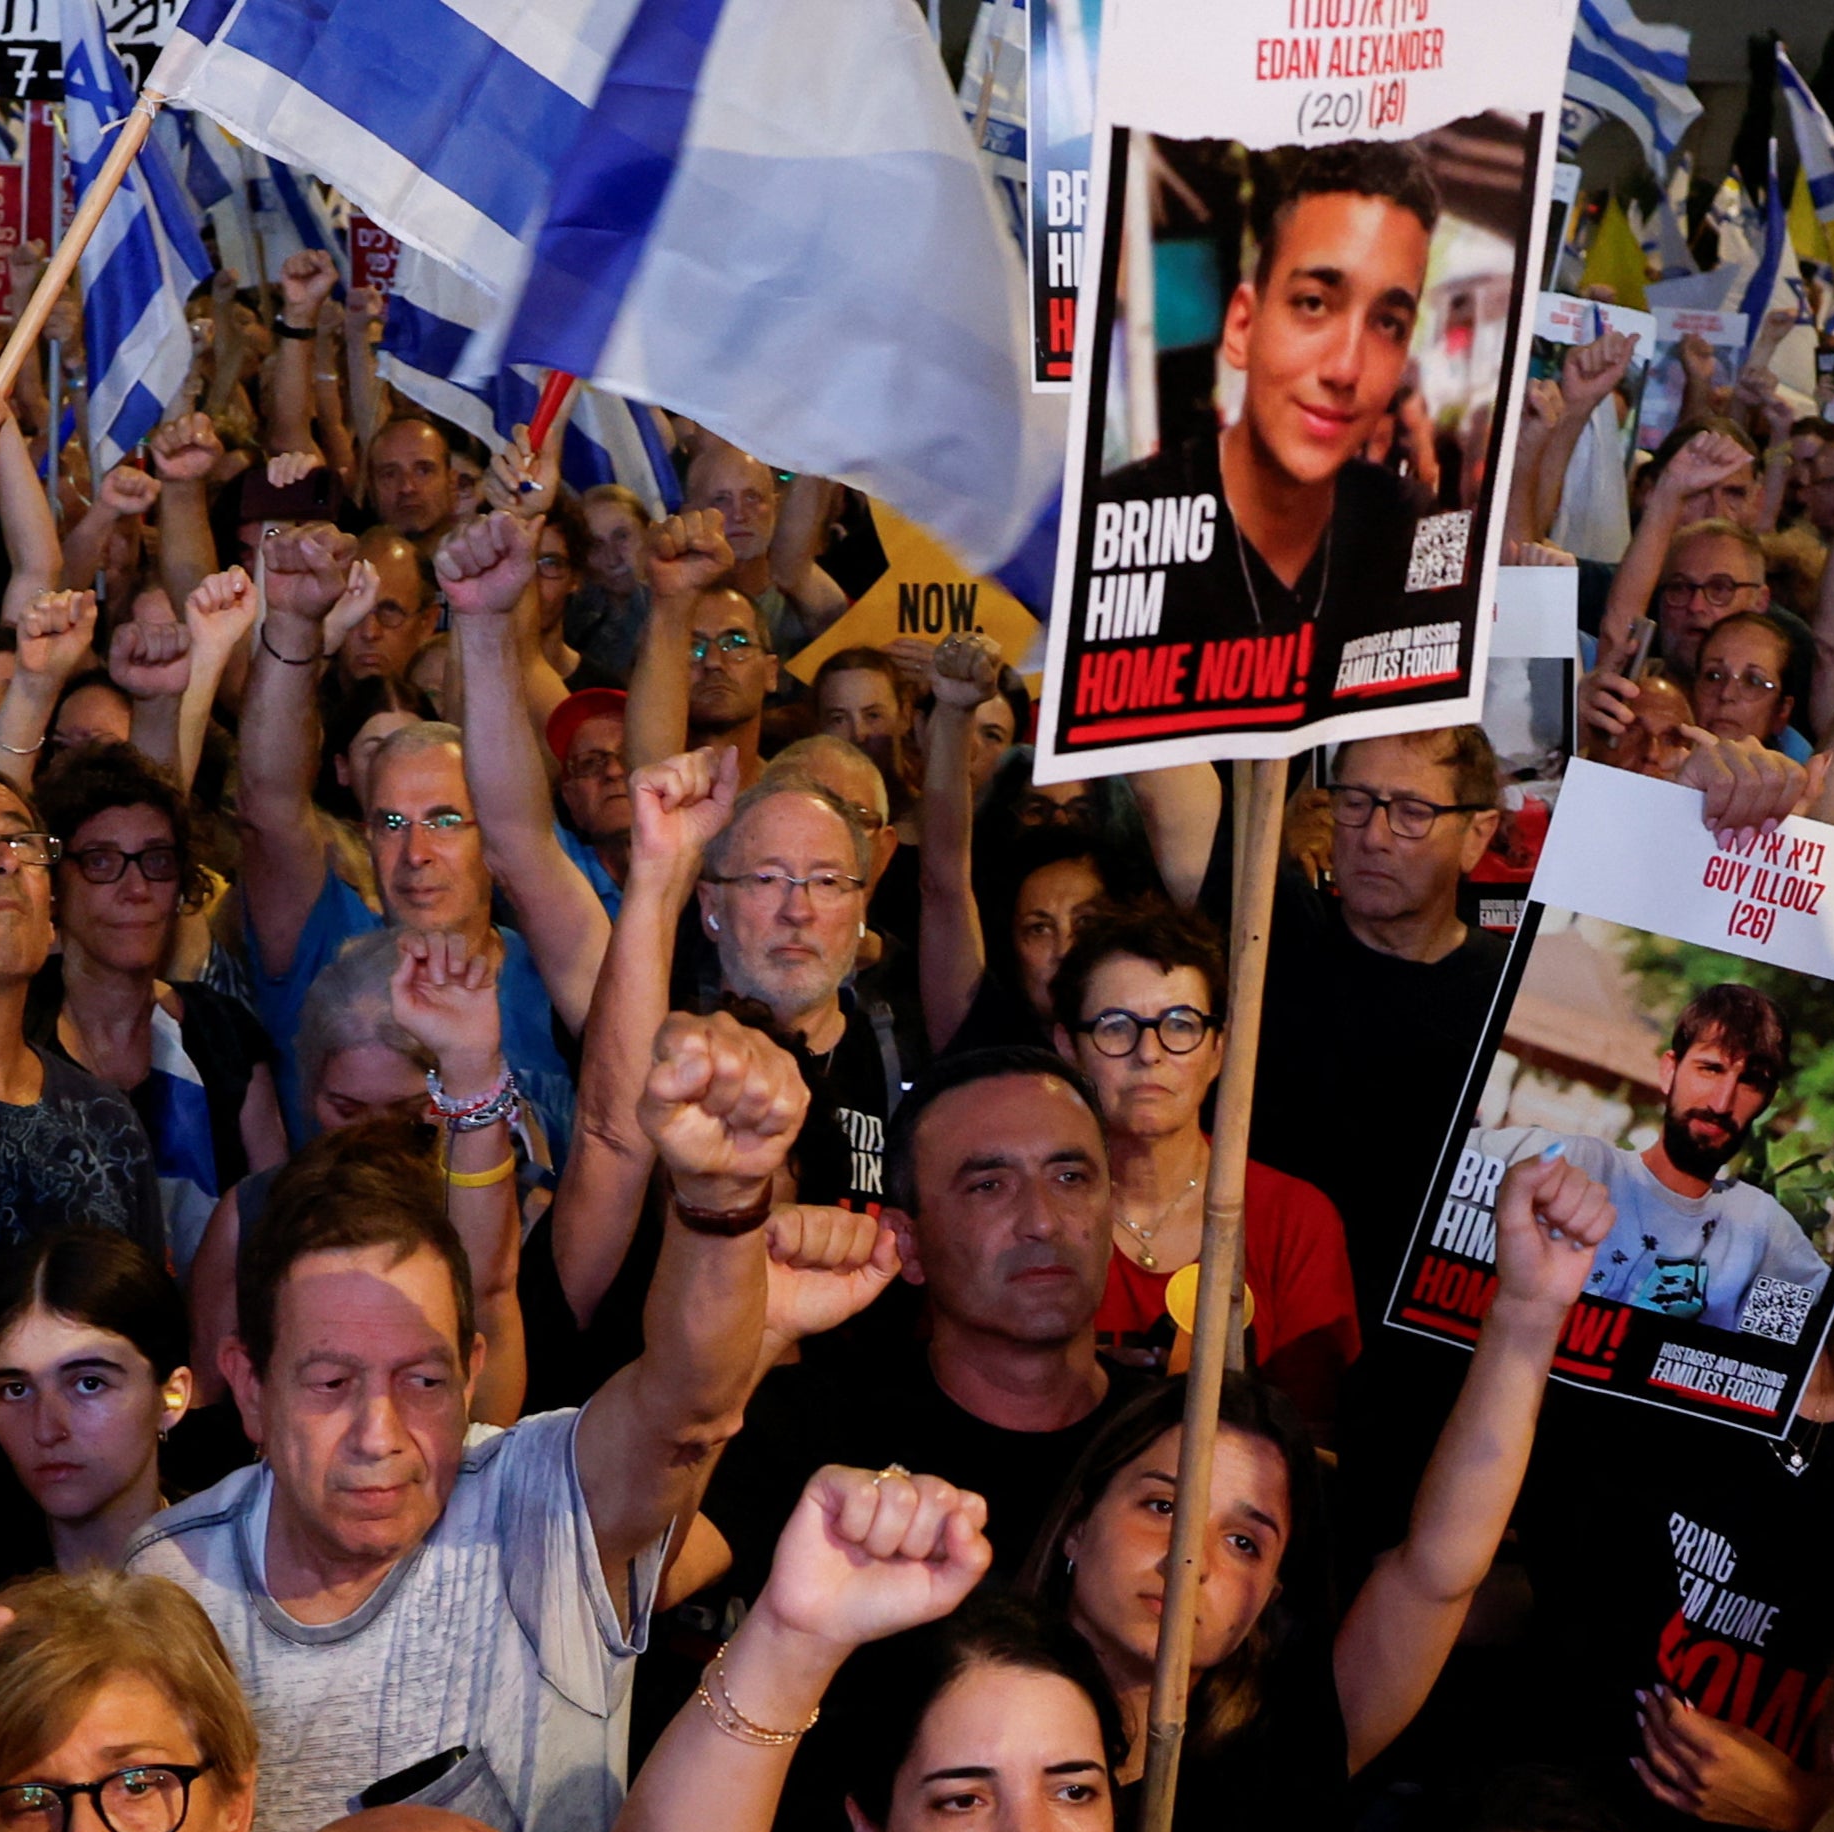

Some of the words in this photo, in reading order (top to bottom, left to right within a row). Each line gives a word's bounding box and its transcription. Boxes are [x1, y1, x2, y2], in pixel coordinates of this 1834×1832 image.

[1256, 37, 1320, 80] EDAN
[1327, 28, 1444, 78] ALEXANDER
[1297, 89, 1362, 135] (20)
[1047, 231, 1084, 288] HI
[1092, 493, 1217, 571] BRING
[1084, 571, 1166, 642] HIM
[1074, 643, 1193, 716] HOME
[1195, 621, 1314, 702] NOW!
[1335, 648, 1400, 691] FAMILIES
[1402, 642, 1459, 679] FORUM
[1703, 855, 1751, 894] GUY
[1749, 867, 1826, 916] ILLOUZ
[1785, 838, 1826, 876] גיא
[1727, 900, 1776, 945] (26)
[1430, 1200, 1497, 1265] HIM
[1412, 1255, 1500, 1320] HOM
[1557, 1302, 1632, 1362] W!
[1650, 1357, 1724, 1396] FAMILIES
[1721, 1377, 1782, 1412] FORUM
[1659, 1341, 1717, 1370] HOSTAGES
[1716, 1356, 1740, 1376] AND
[1737, 1362, 1788, 1389] MISSING
[1705, 1588, 1780, 1648] HOME
